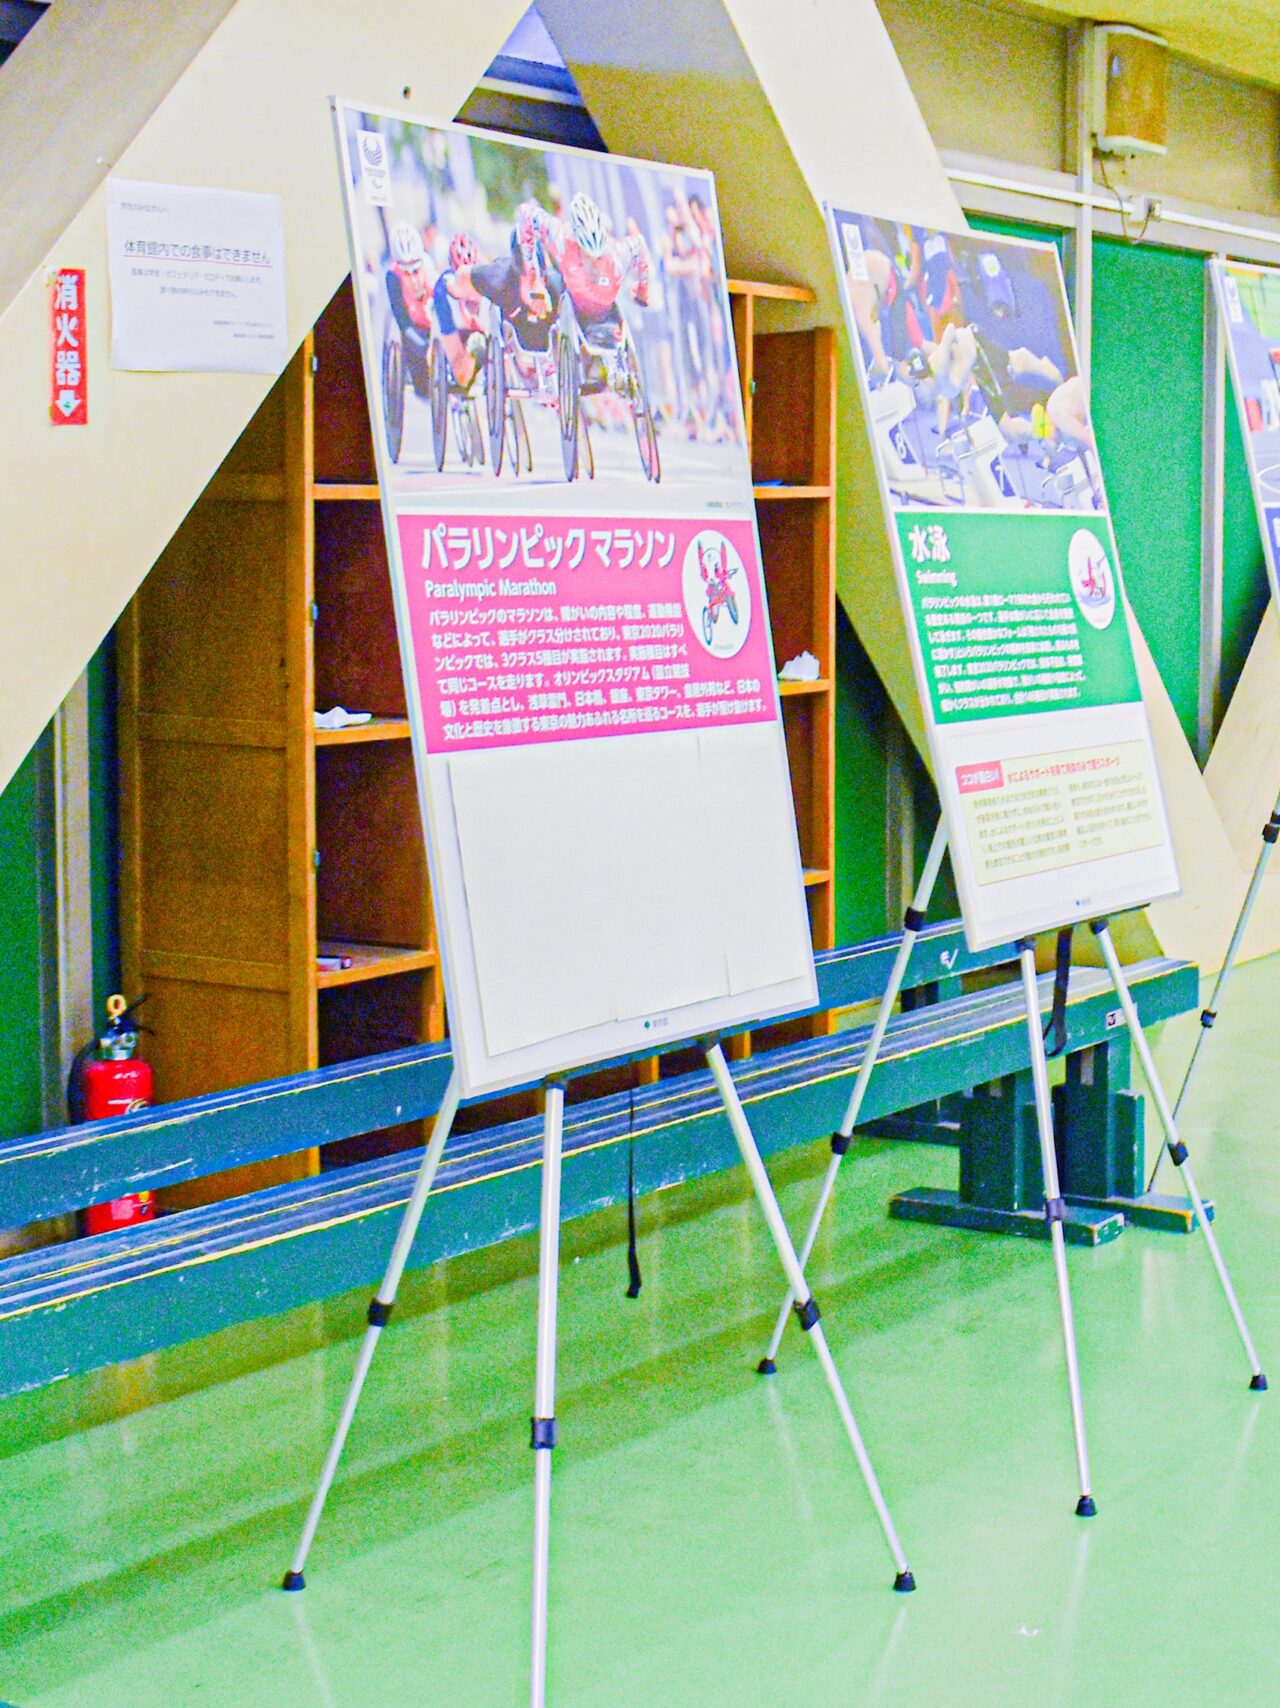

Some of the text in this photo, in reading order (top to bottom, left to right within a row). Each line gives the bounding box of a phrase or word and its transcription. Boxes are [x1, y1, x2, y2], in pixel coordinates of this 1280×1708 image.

[54, 273, 82, 386] 消火器
[908, 524, 951, 563] 水泳
[425, 577, 557, 601] Paralympic Marathon
